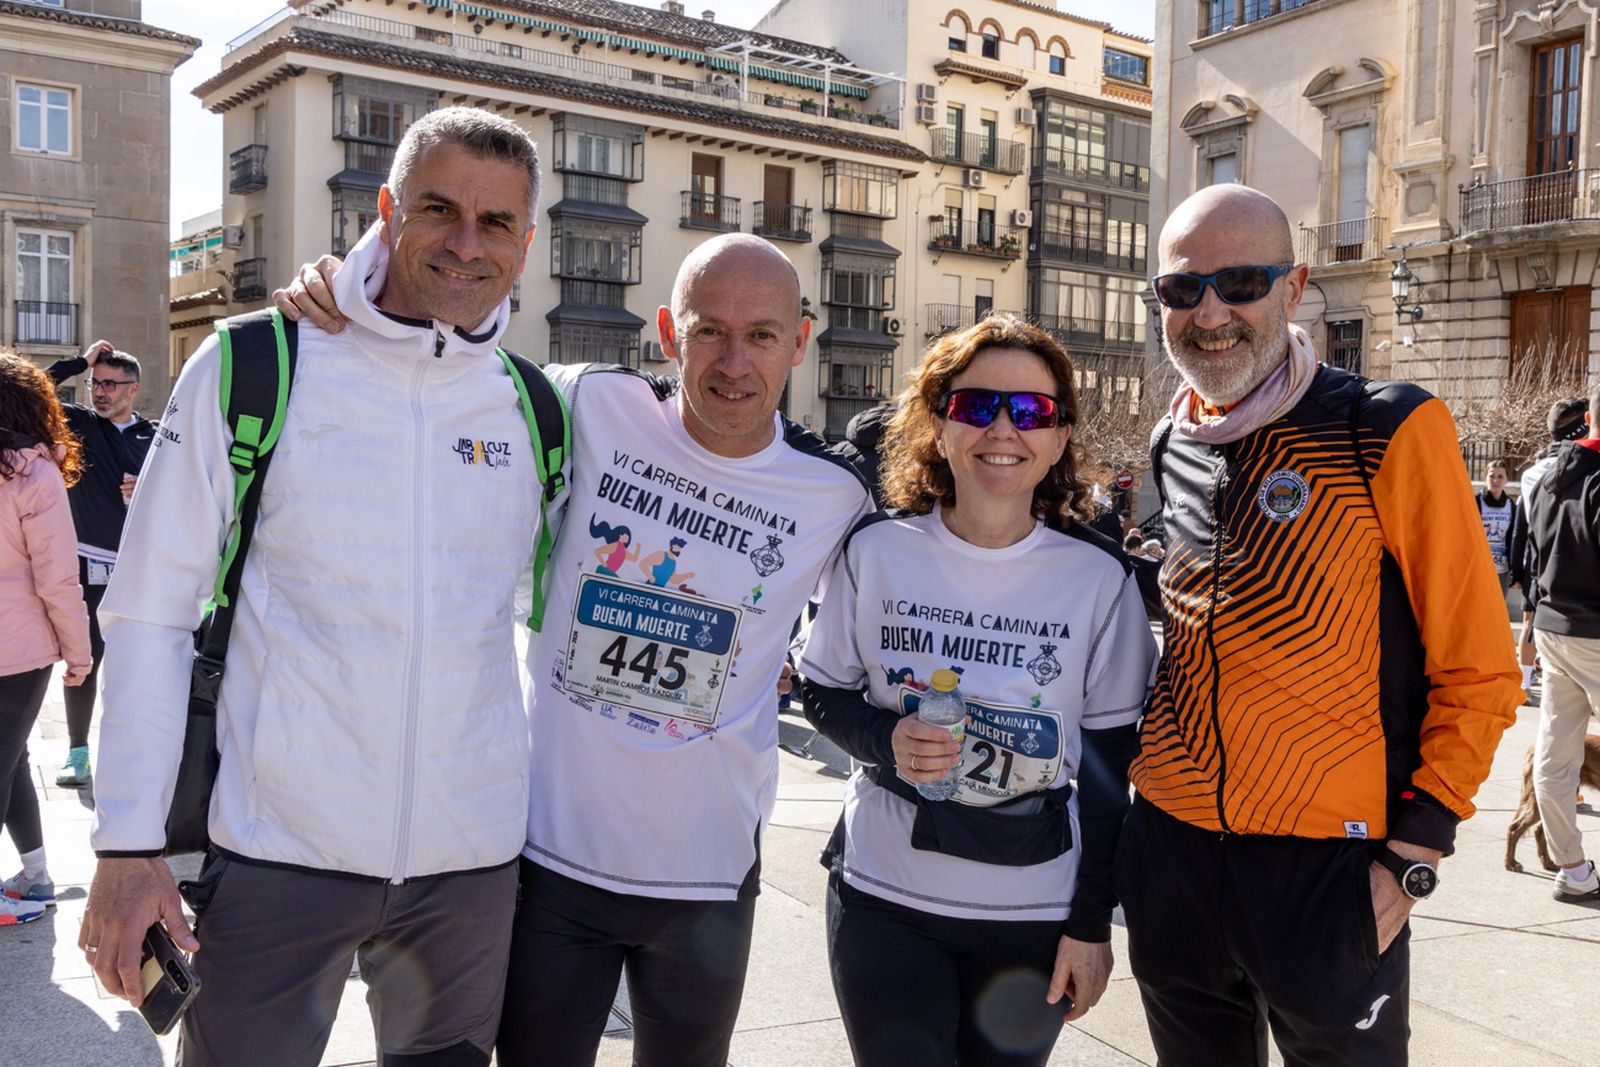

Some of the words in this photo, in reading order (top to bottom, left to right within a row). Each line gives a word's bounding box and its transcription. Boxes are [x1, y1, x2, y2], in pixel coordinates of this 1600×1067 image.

[613, 450, 629, 470] VI
[632, 459, 708, 502] CARRERA
[713, 492, 796, 536] CAMINATA
[597, 472, 663, 521] BUENA
[666, 502, 753, 555] MUERTE
[592, 604, 632, 629] BUENA
[635, 613, 690, 641] MUERTE
[599, 588, 608, 599] VI
[610, 591, 659, 611] CARRERA
[662, 602, 718, 624] CAMINATA
[882, 600, 893, 615] VI
[897, 600, 974, 628] CARRERA
[980, 614, 1070, 639] CAMINATA
[599, 635, 690, 691] 445
[881, 626, 934, 654] BUENA
[941, 634, 1026, 668] MUERTE
[967, 720, 1015, 747] MUERTE
[986, 712, 1042, 730] CAMINATA
